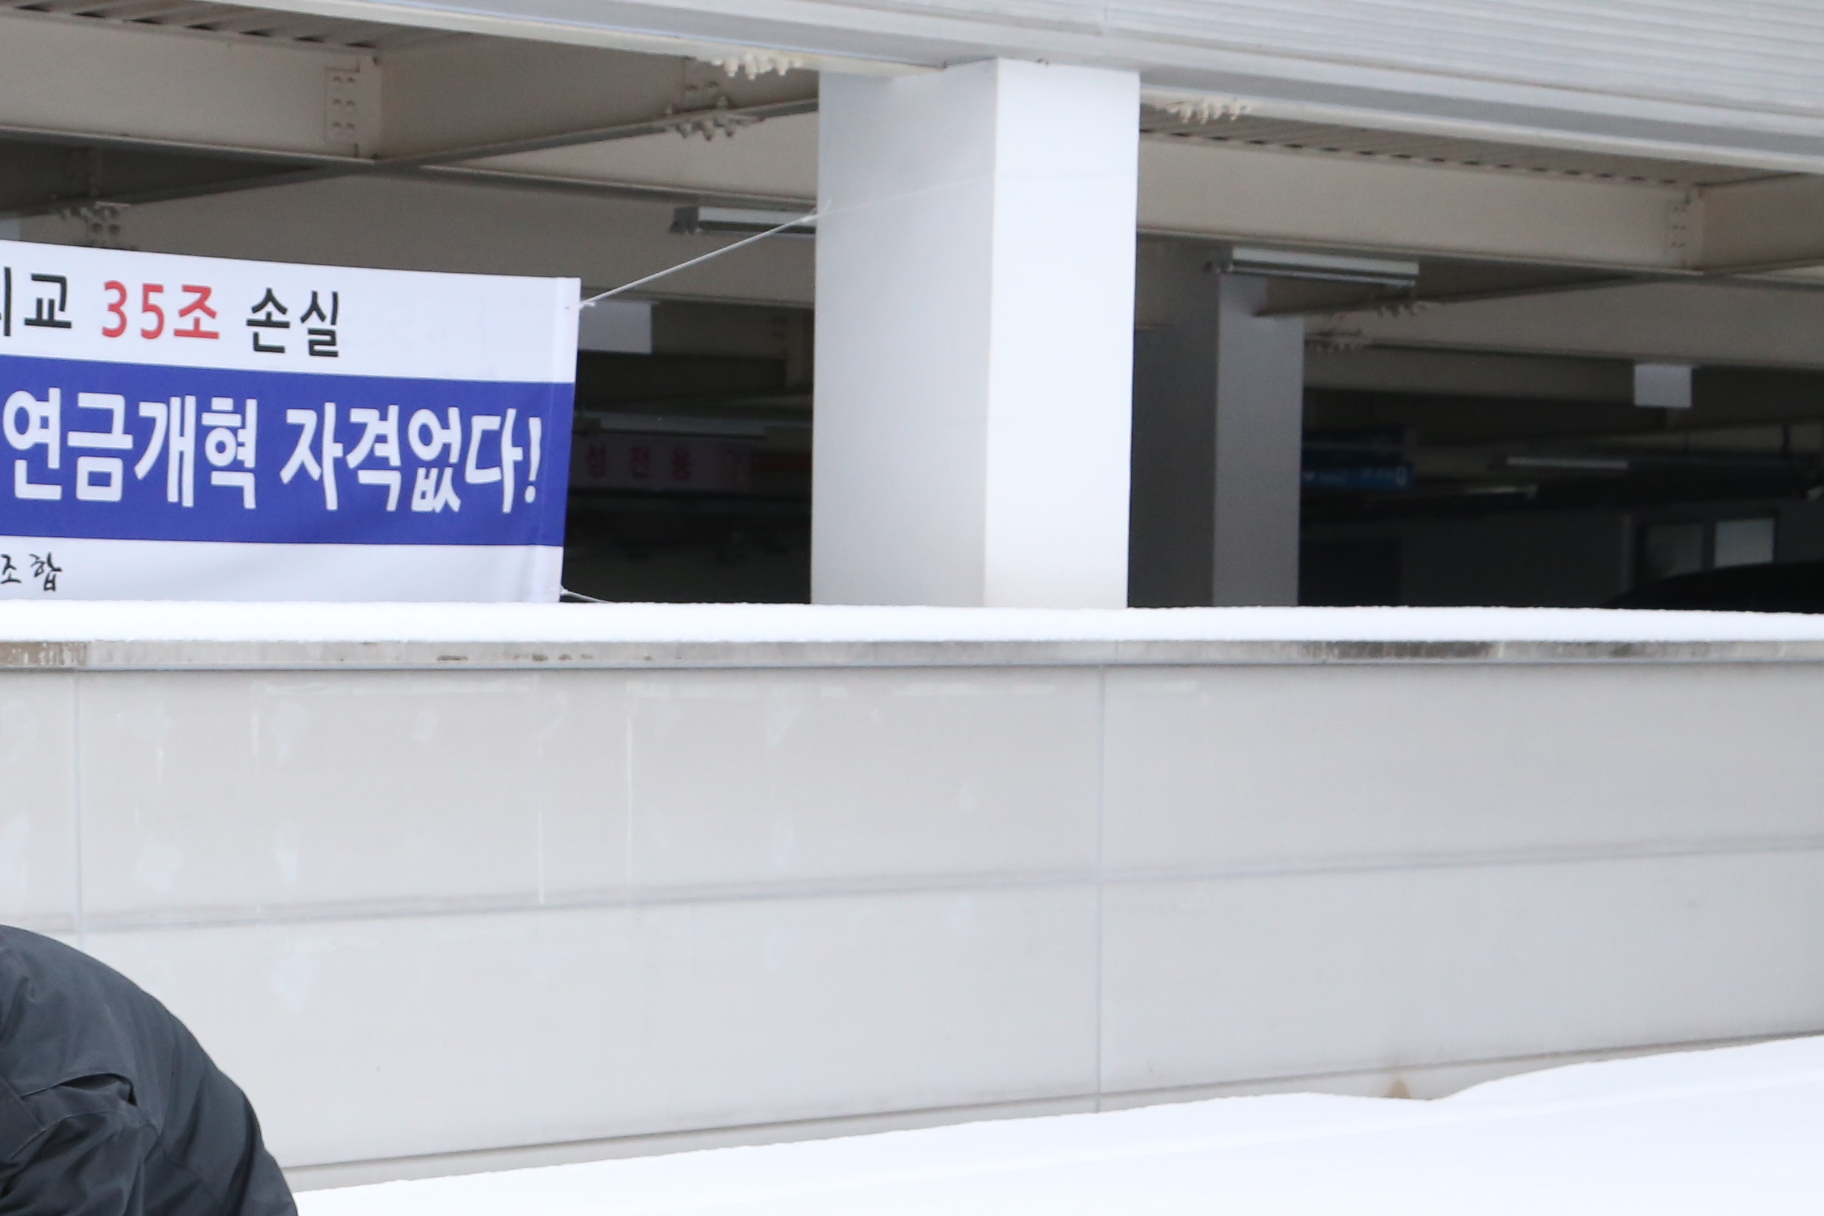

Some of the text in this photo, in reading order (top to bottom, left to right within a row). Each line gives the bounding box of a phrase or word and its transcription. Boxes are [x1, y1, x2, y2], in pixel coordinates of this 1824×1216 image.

[102, 281, 221, 341] 35조
[245, 288, 341, 359] 손실
[2, 387, 259, 511] 연금개혁
[279, 402, 544, 514] 자격없다!
